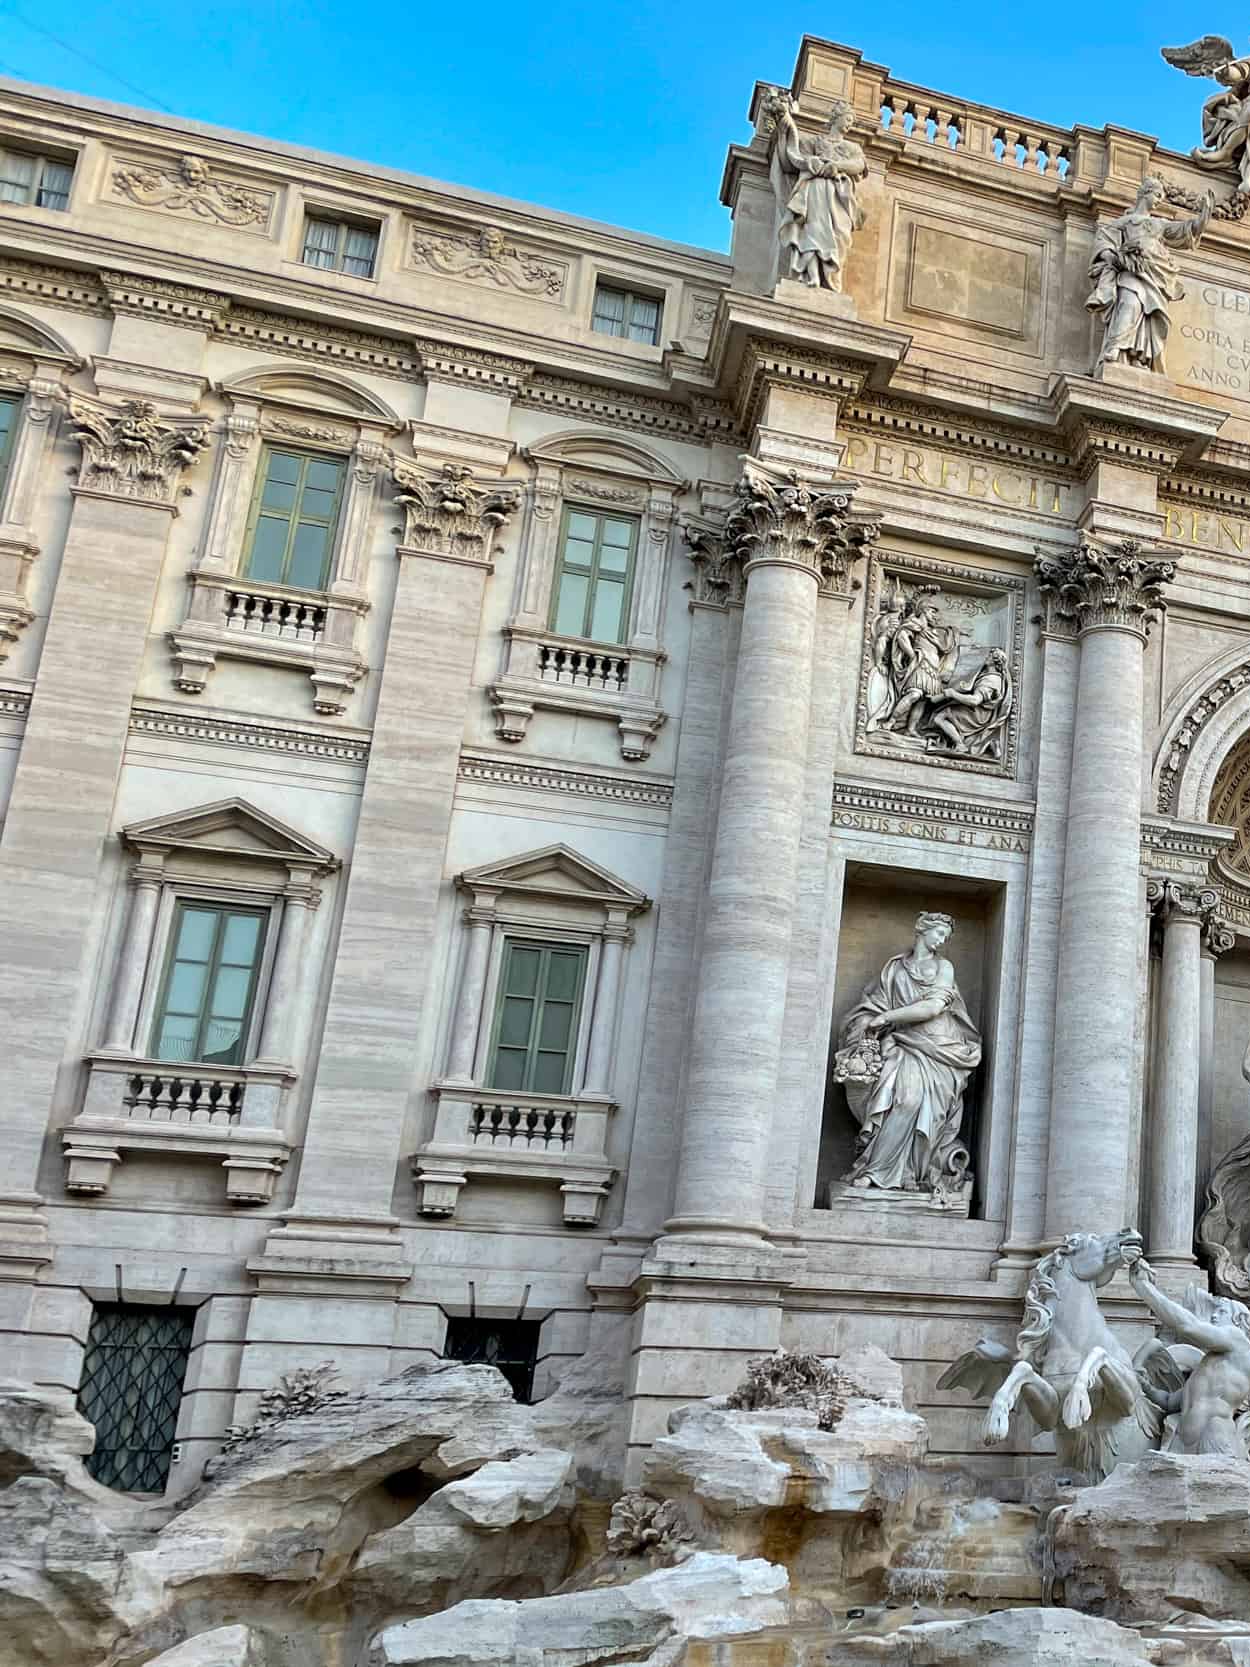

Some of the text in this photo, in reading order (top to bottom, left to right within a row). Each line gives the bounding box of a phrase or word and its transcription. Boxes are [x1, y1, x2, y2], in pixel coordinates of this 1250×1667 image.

[1180, 324, 1233, 349] COPIA
[1187, 365, 1241, 389] ANNO
[843, 437, 1070, 513] PERFECIT
[831, 811, 1026, 851] POSITIS SIGNIS ET ANA
